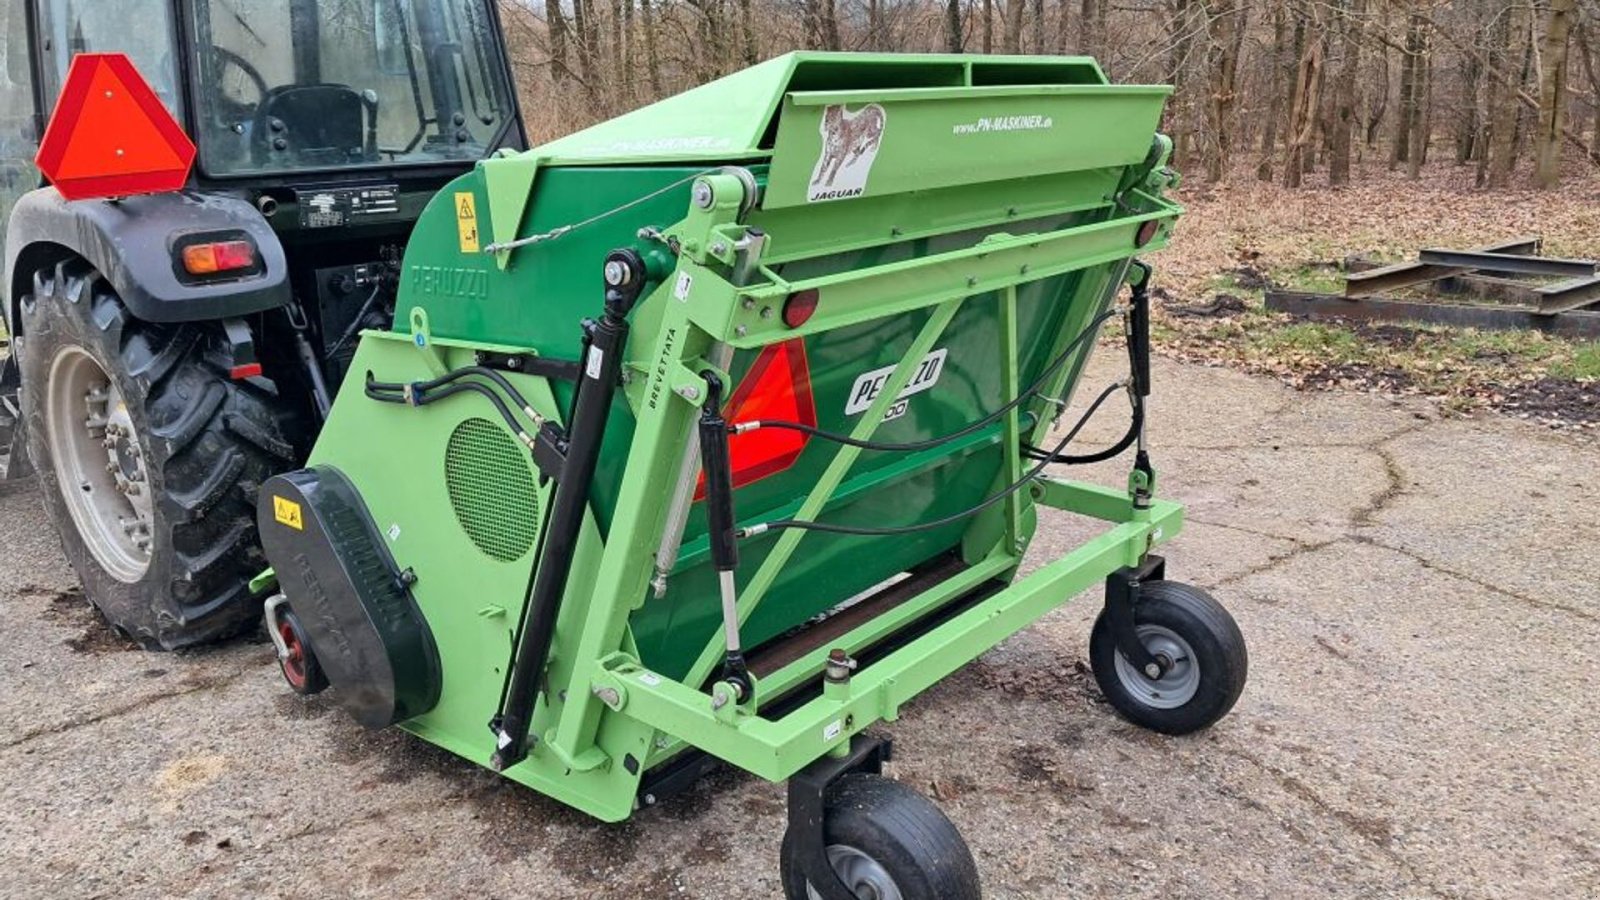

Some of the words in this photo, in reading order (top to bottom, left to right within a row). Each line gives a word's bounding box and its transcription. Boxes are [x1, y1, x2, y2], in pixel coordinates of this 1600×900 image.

[811, 187, 862, 201] JAGUAR
[411, 265, 488, 300] PERUZZO
[648, 327, 677, 410] BREVETTATA
